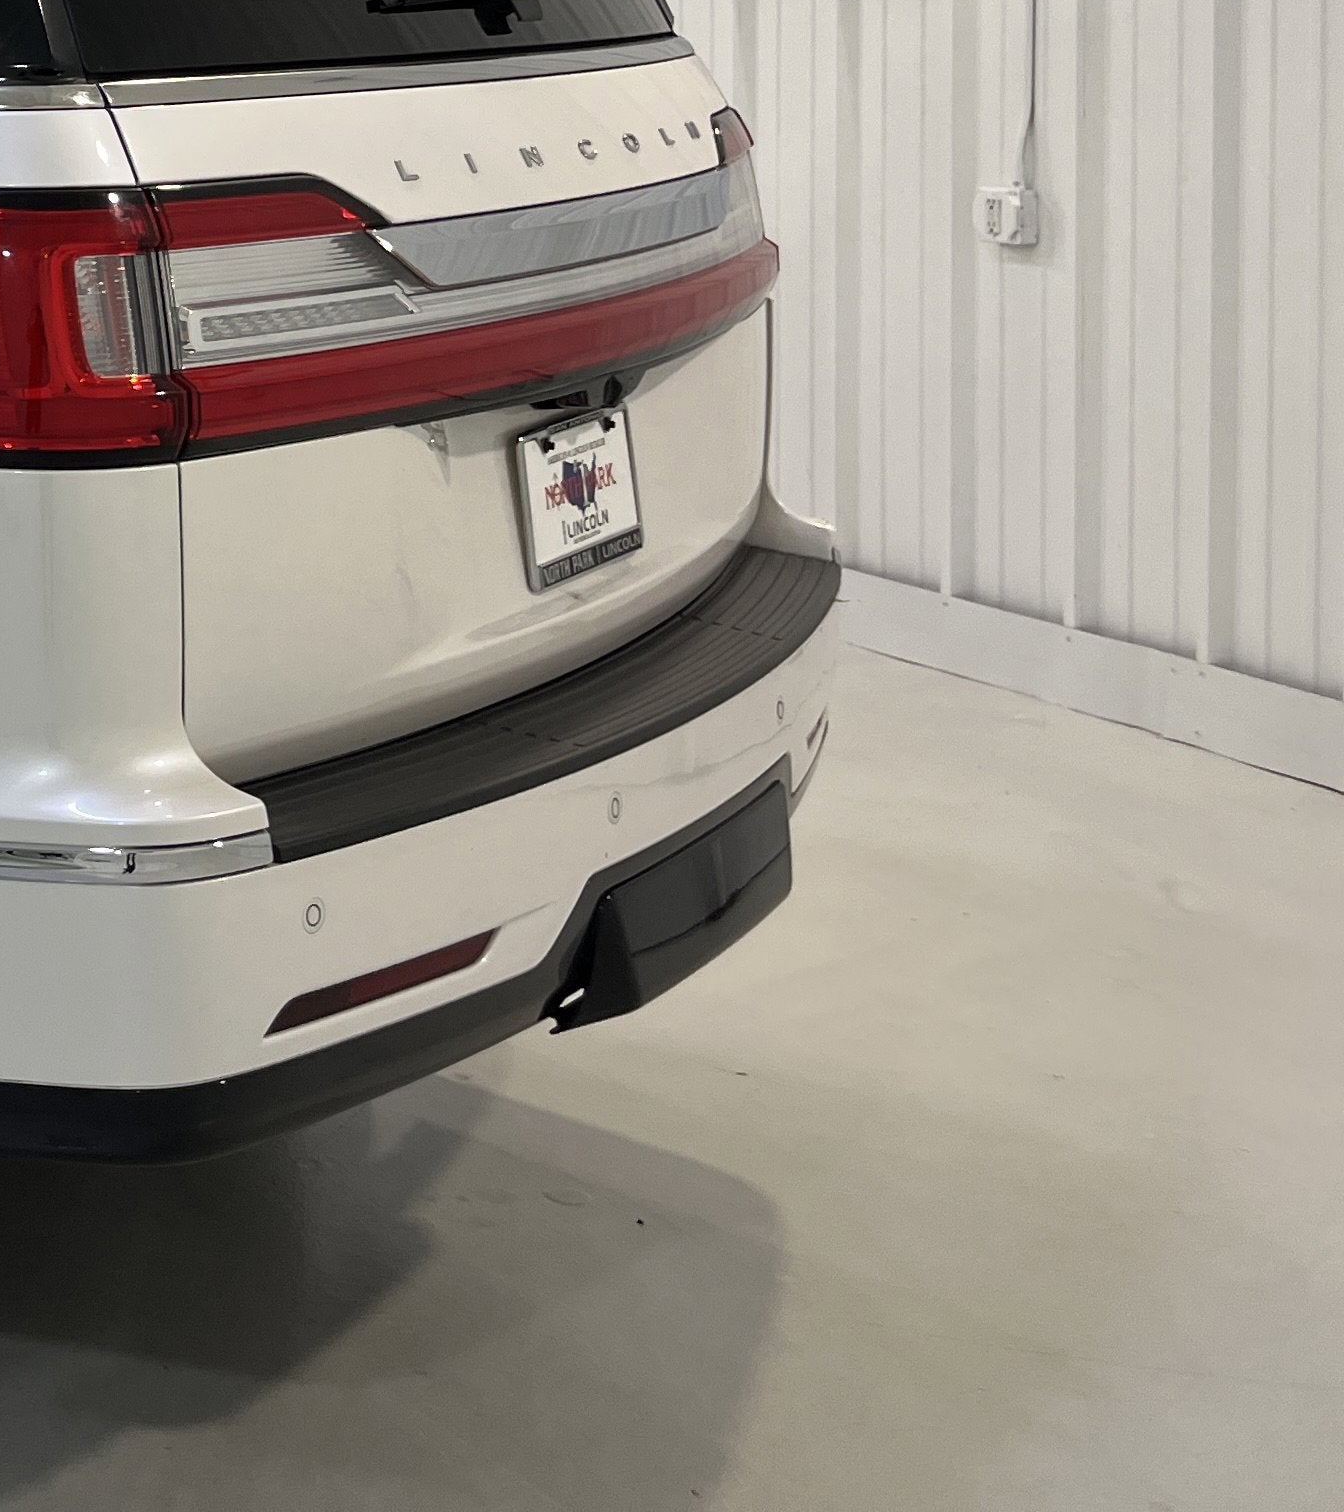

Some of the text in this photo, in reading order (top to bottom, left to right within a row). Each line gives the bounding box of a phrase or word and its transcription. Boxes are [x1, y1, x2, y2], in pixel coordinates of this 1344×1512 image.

[394, 121, 701, 182] LINCOLN
[567, 509, 609, 538] LINCOLN
[572, 550, 596, 573] PARK
[602, 532, 641, 558] LINCOLN
